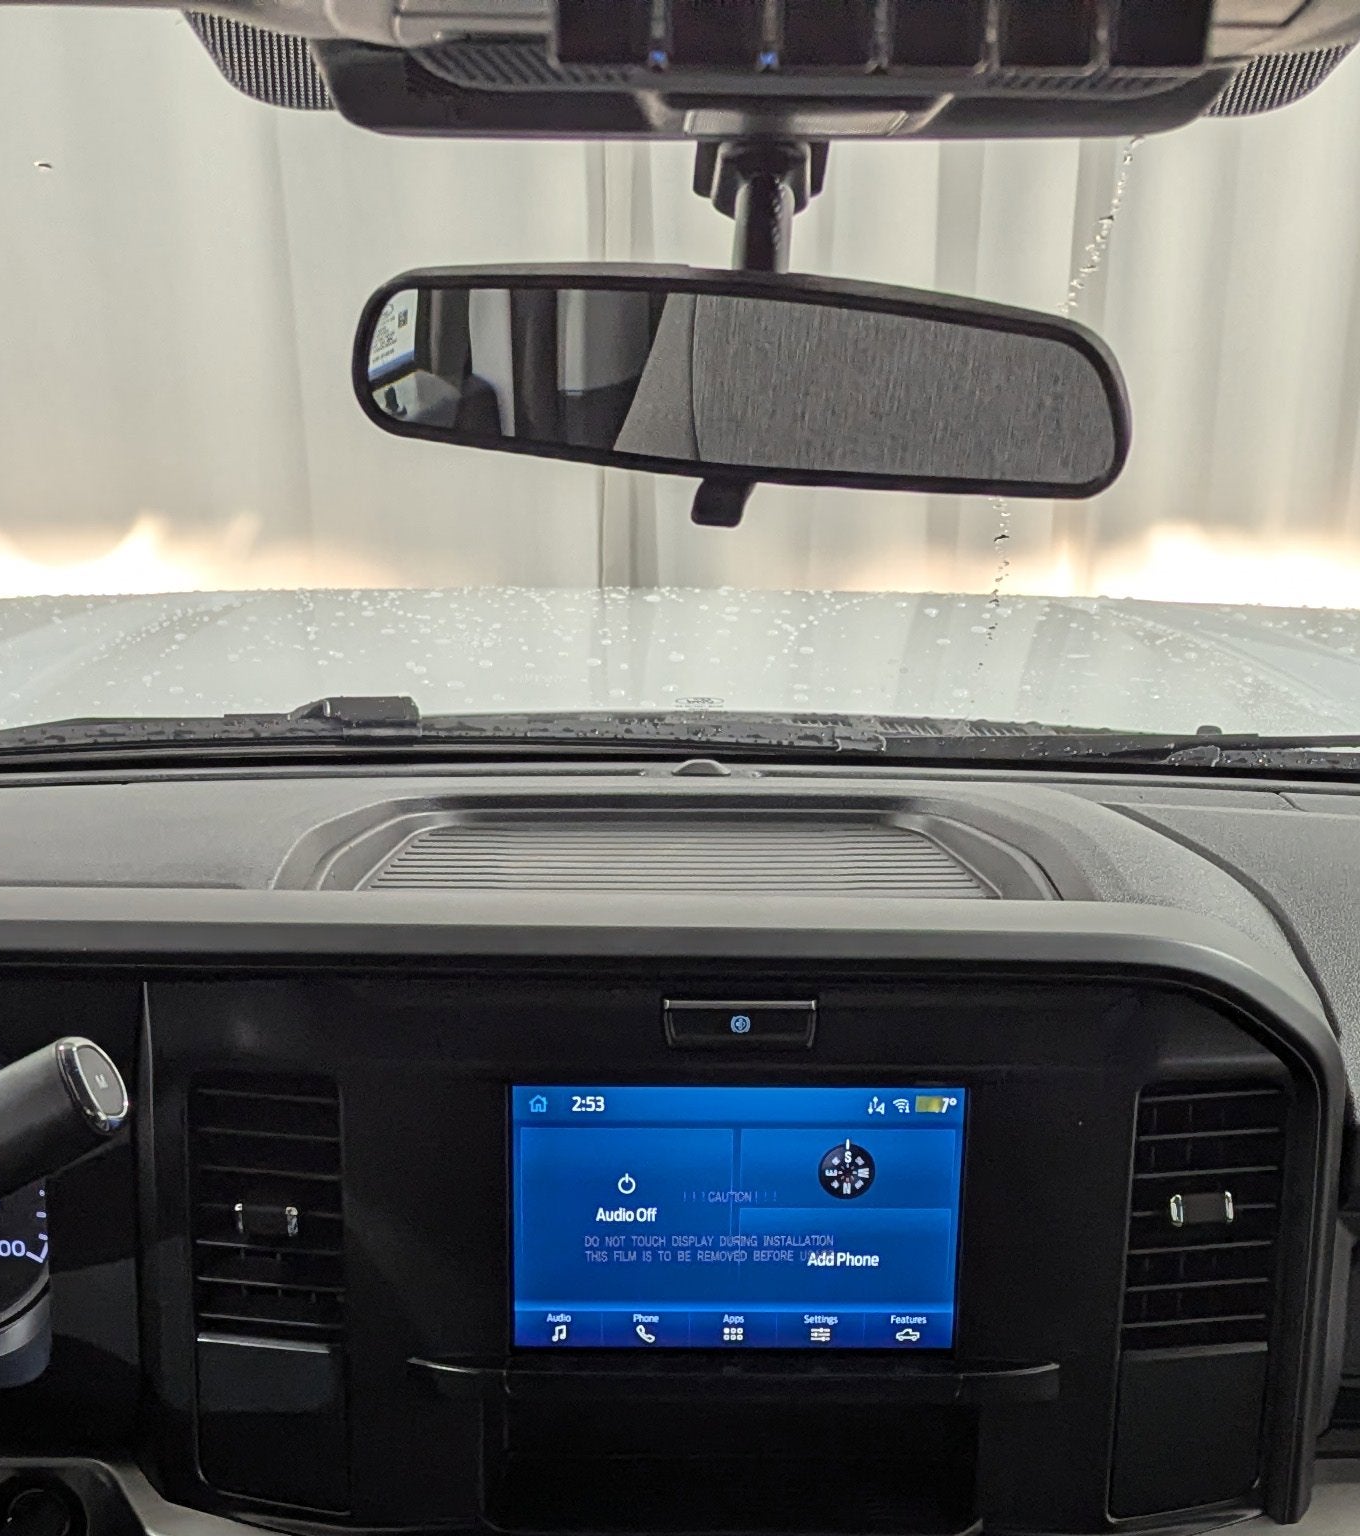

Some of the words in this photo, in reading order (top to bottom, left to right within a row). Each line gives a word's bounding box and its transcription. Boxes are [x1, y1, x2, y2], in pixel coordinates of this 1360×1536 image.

[571, 1096, 605, 1111] 2:53
[844, 1151, 852, 1163] S
[843, 1182, 851, 1194] N
[707, 1191, 752, 1202] CAUTION
[595, 1207, 634, 1222] Audio
[636, 1207, 657, 1222] Off
[584, 1236, 599, 1247] DO
[605, 1236, 626, 1247] NOT
[632, 1236, 666, 1247] TOUCH
[671, 1236, 714, 1247] DISPLAY
[719, 1236, 757, 1247] DURING
[763, 1235, 834, 1247] INSTALLATION
[585, 1250, 608, 1262] THIS
[613, 1250, 637, 1262] FILM
[642, 1250, 652, 1262] IS
[658, 1250, 672, 1262] TO
[678, 1250, 691, 1262] BE
[697, 1250, 747, 1262] REMOVED
[753, 1250, 793, 1262] BEFORE
[807, 1252, 834, 1267] Add
[836, 1252, 879, 1267] Phone
[546, 1312, 571, 1323] Audio
[633, 1313, 659, 1324] Phone
[723, 1313, 744, 1325] Apps
[803, 1313, 838, 1325] Settings
[890, 1313, 927, 1325] Features
